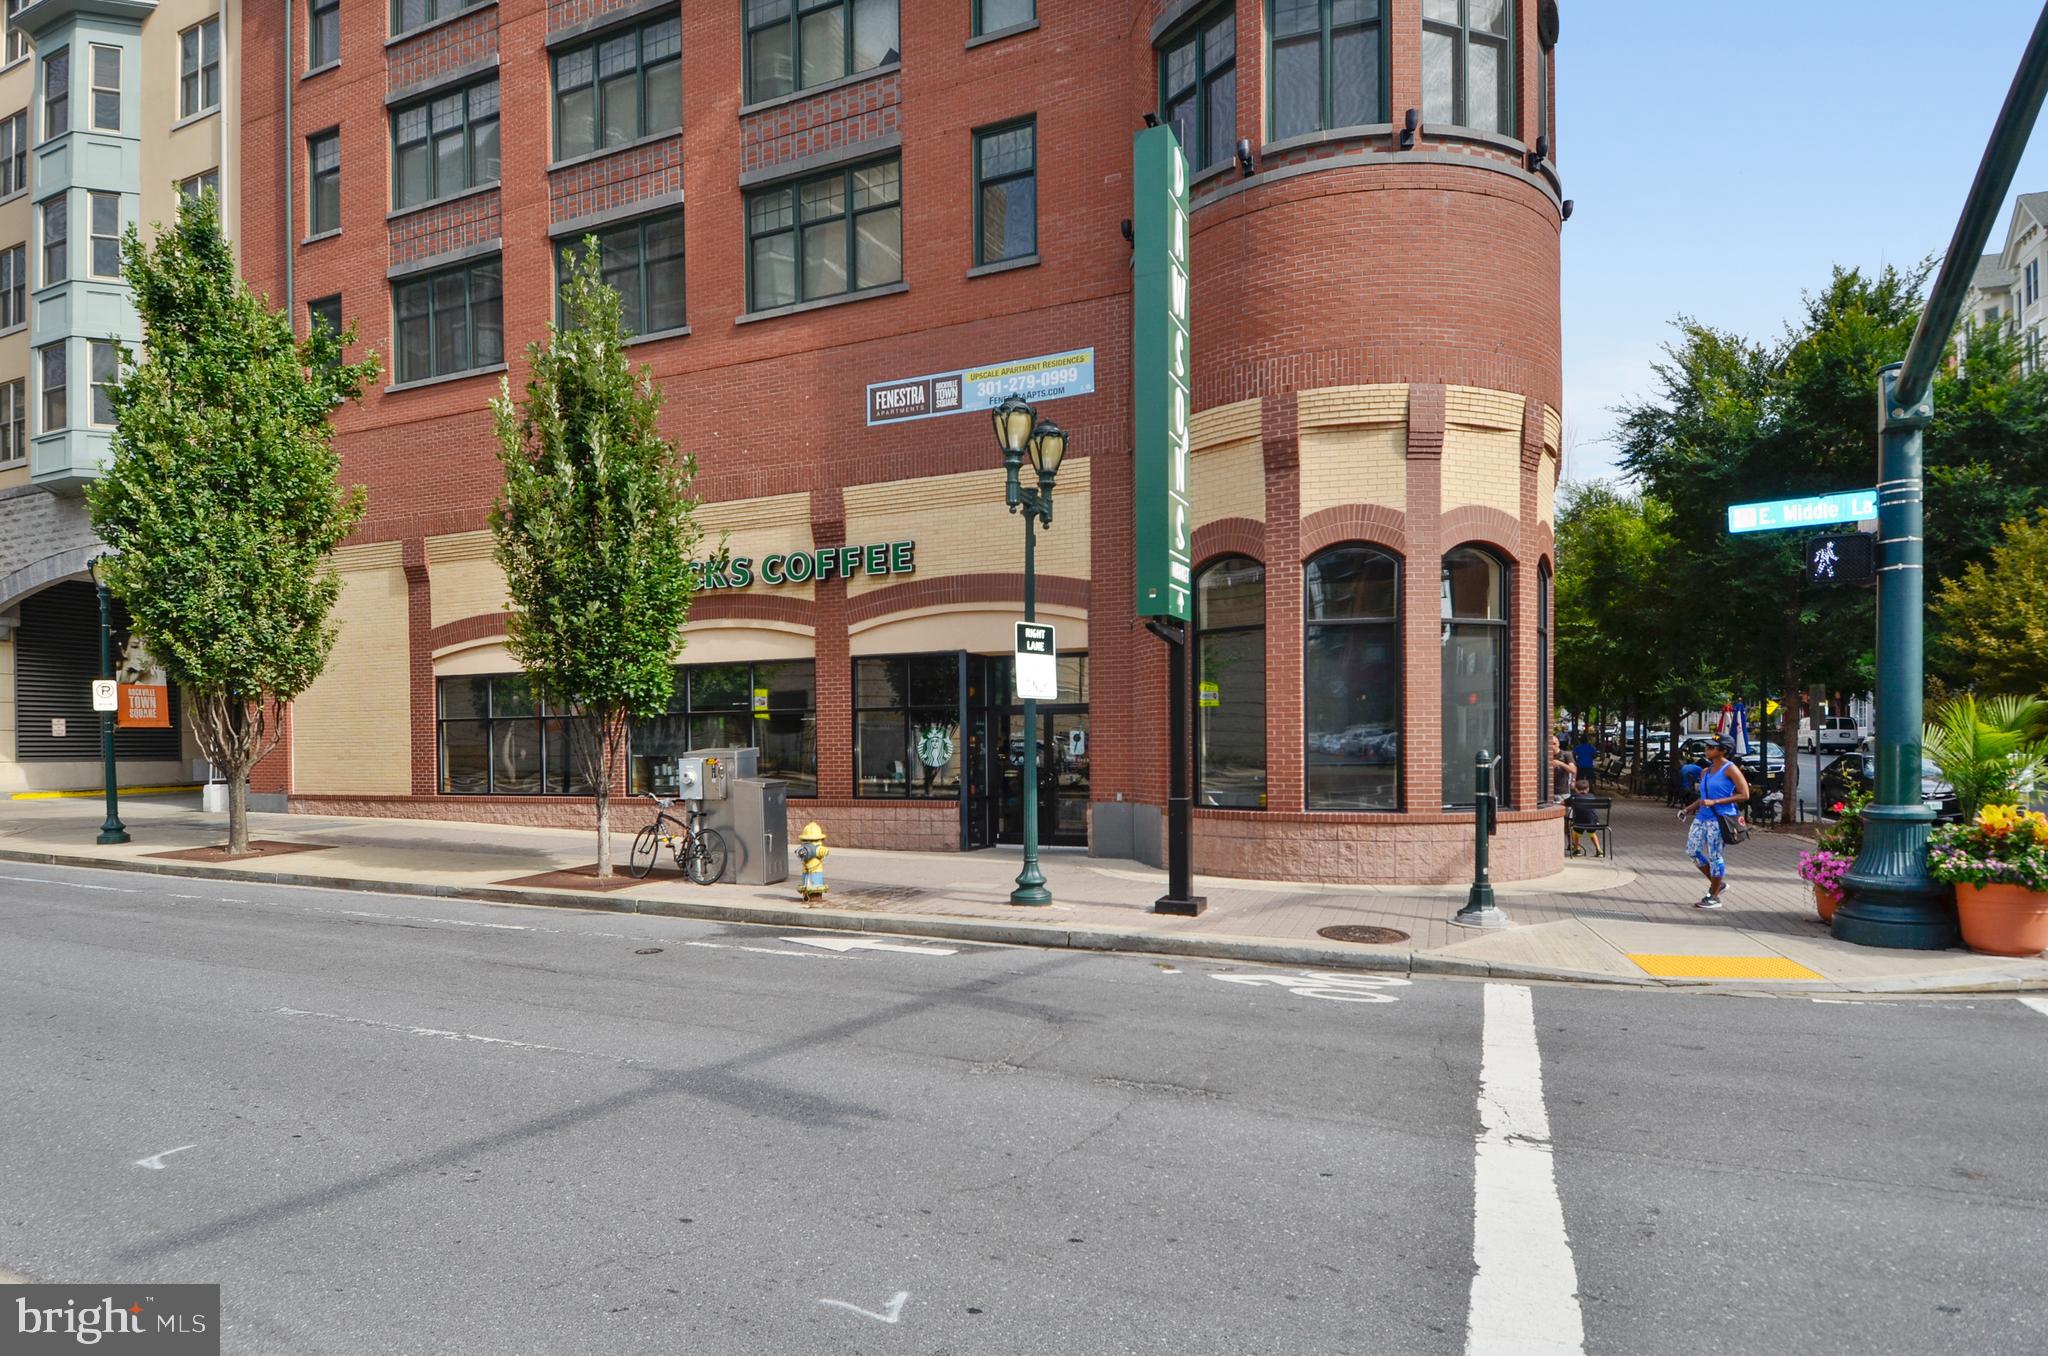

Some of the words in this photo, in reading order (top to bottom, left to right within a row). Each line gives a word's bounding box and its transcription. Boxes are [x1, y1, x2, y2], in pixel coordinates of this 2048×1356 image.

[970, 370, 1001, 381] UPSCALE
[1001, 364, 1040, 375] APARTMENT
[1042, 355, 1085, 368] RESIDENCES
[977, 367, 1078, 396] 301-279-0999
[875, 385, 925, 410] FENESTRA
[935, 385, 958, 400] TOWN
[876, 405, 925, 417] APARTMENTS
[1759, 508, 1776, 525] E.
[1784, 502, 1839, 523] Middle
[760, 540, 914, 585] COFFEE
[1025, 627, 1046, 639] RIGHT
[1026, 640, 1045, 652] LANE
[128, 696, 156, 709] TOWN
[129, 708, 158, 719] SQUARE
